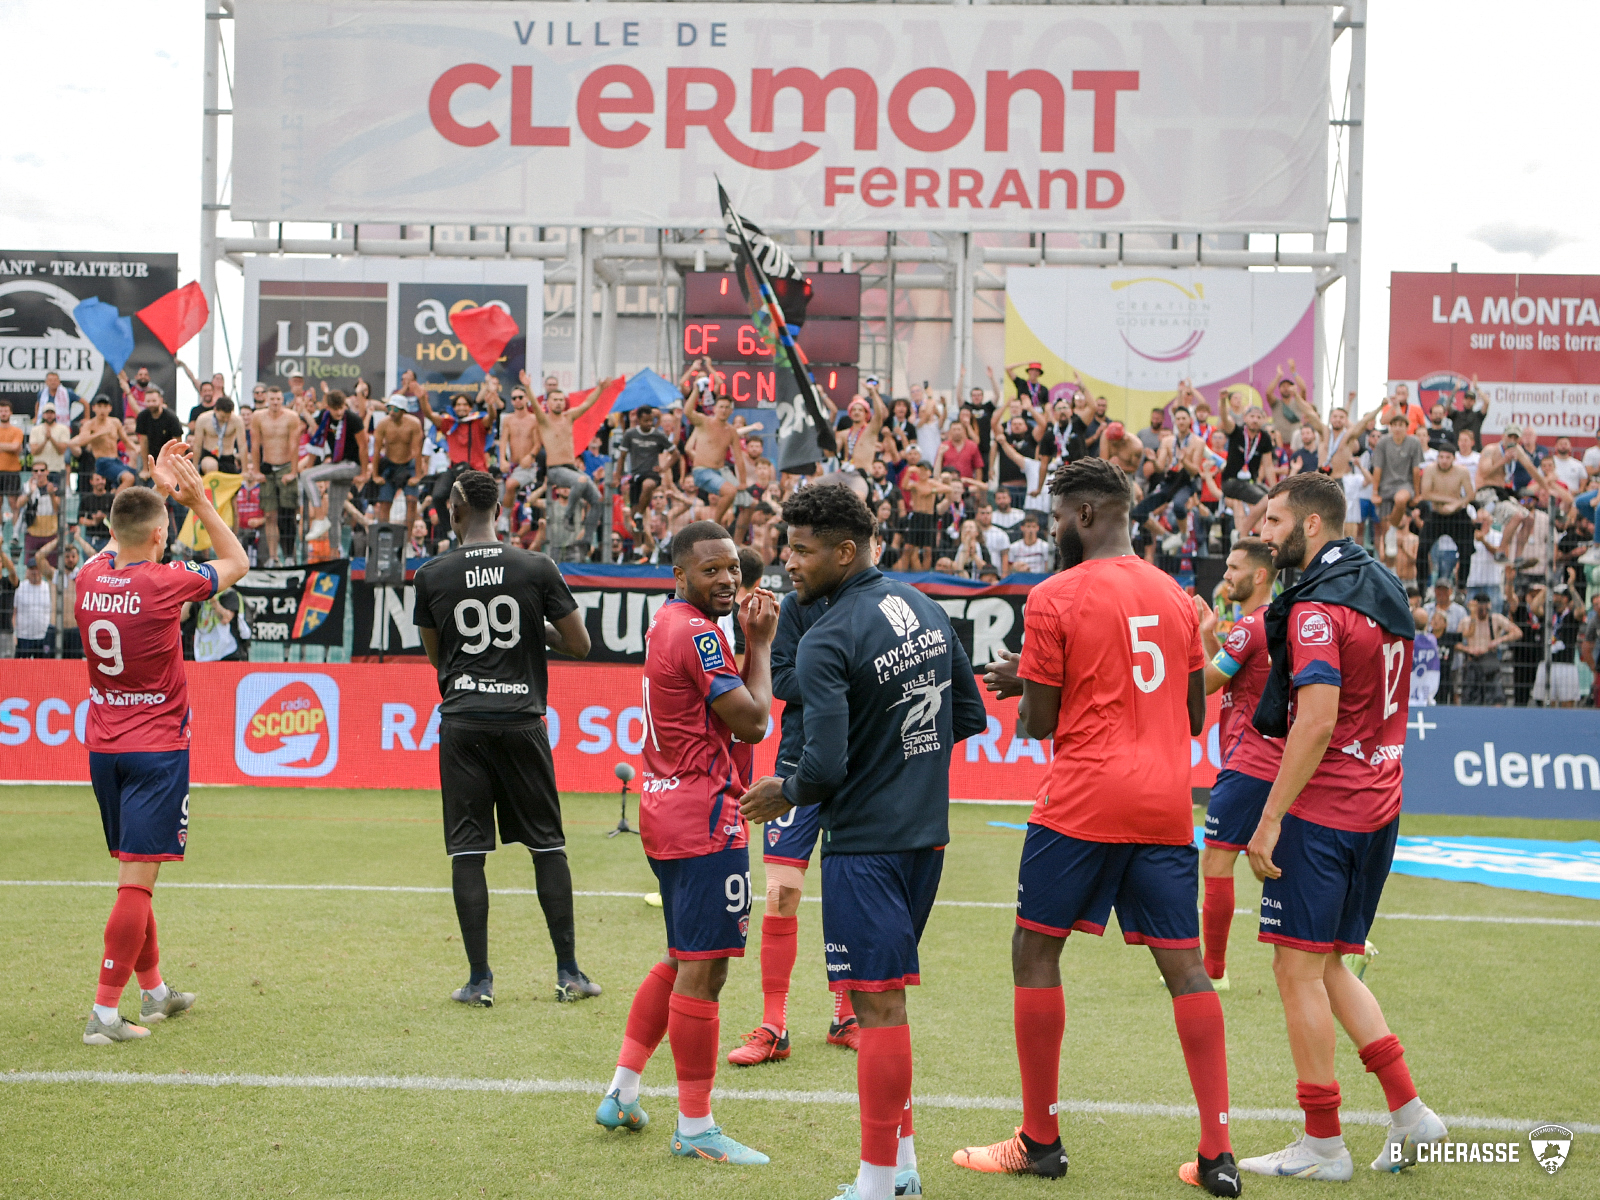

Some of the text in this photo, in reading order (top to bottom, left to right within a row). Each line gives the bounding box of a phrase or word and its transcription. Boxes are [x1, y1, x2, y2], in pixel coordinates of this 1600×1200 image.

[514, 21, 728, 47] VILLE DE
[428, 61, 1139, 170] CLERMONT
[824, 166, 1125, 210] FERRAND
[50, 261, 149, 277] TRAITEUR
[1432, 295, 1474, 324] LA
[275, 320, 370, 358] LEO
[684, 324, 721, 354] CF
[1469, 333, 1496, 350] sur
[1500, 331, 1534, 350] tous
[1538, 330, 1560, 350] les
[307, 358, 361, 379] Resto
[1511, 411, 1600, 433] montag
[453, 594, 522, 655] 99
[1303, 622, 1327, 633] SCOOP
[88, 619, 125, 676] 9
[873, 628, 946, 674] PUY-DE-DÔME
[1128, 614, 1166, 693] 5
[877, 644, 948, 685] LE DÉPARTEMENT
[477, 682, 529, 695] BATIPRO
[1382, 640, 1405, 721] 12
[106, 692, 166, 706] BATIPRO
[280, 696, 311, 711] radio
[251, 708, 325, 738] SCOOP
[1453, 741, 1600, 791] clerm
